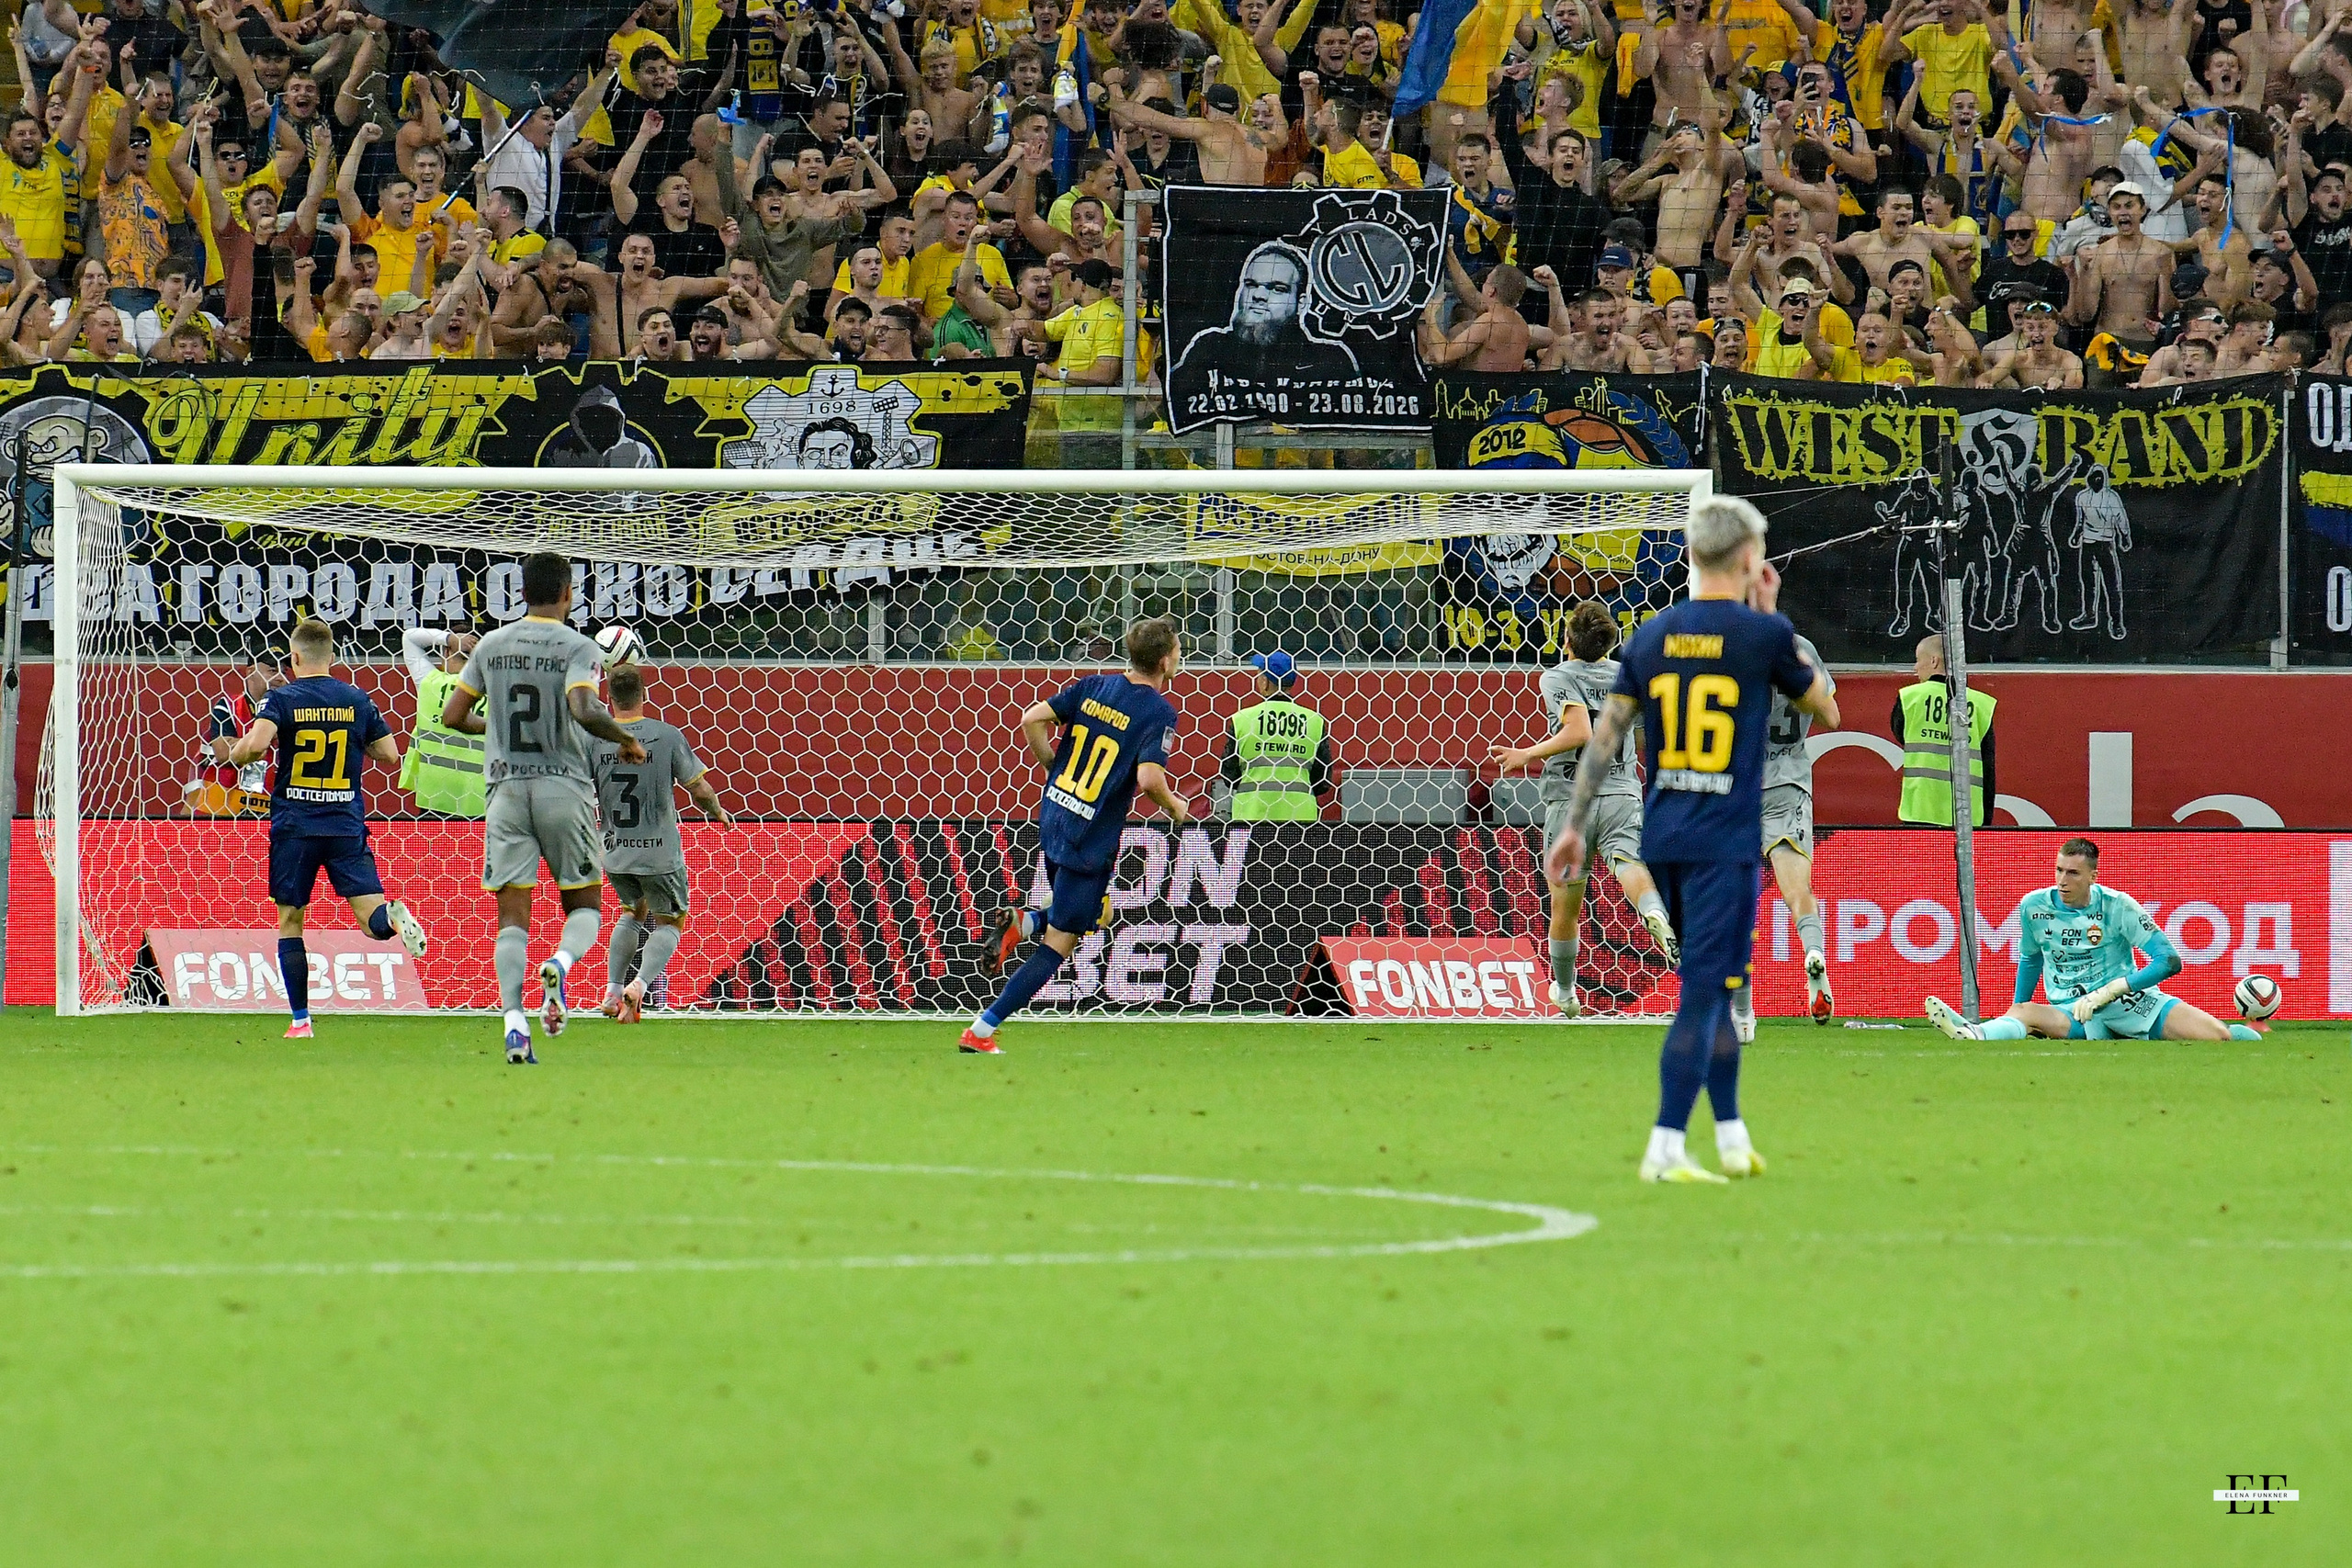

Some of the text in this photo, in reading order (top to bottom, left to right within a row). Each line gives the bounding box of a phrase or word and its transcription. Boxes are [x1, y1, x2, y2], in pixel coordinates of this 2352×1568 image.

[1347, 208, 1413, 235] LADS
[808, 400, 856, 414] 1698
[1188, 392, 1288, 414] 22.02.1990
[1309, 393, 1419, 415] 23.08.2026
[1479, 428, 1526, 456] 2012
[1733, 403, 1959, 479] WEST
[2041, 406, 2272, 480] BAND
[1255, 547, 1380, 566] ОСТОВ-НА-ДОНУ
[181, 562, 461, 631] ГОРОДА
[486, 561, 688, 627] ОНО
[487, 655, 531, 671] МАТЕУС
[293, 705, 356, 723] ШАНТАЛИЙ
[509, 684, 542, 752] 2
[1080, 697, 1131, 731] КОМАРОВ
[1258, 710, 1307, 739] 18098
[1648, 672, 1740, 773] 16
[1925, 694, 1974, 728] 182
[1255, 742, 1306, 754] STEWARD
[1921, 728, 1973, 744] STEW
[289, 729, 351, 790] 21
[600, 750, 653, 766] КРУЙ
[1055, 724, 1120, 803] 10
[286, 787, 356, 803] РОСТСЕЛЬМАШ
[611, 773, 639, 829] 3
[616, 838, 663, 850] РОССЕТИ
[2086, 911, 2103, 921] wb
[2062, 929, 2082, 937] FON
[2062, 938, 2082, 946] BET
[174, 952, 403, 1000] FONBET
[1349, 960, 1537, 1009] FONBET
